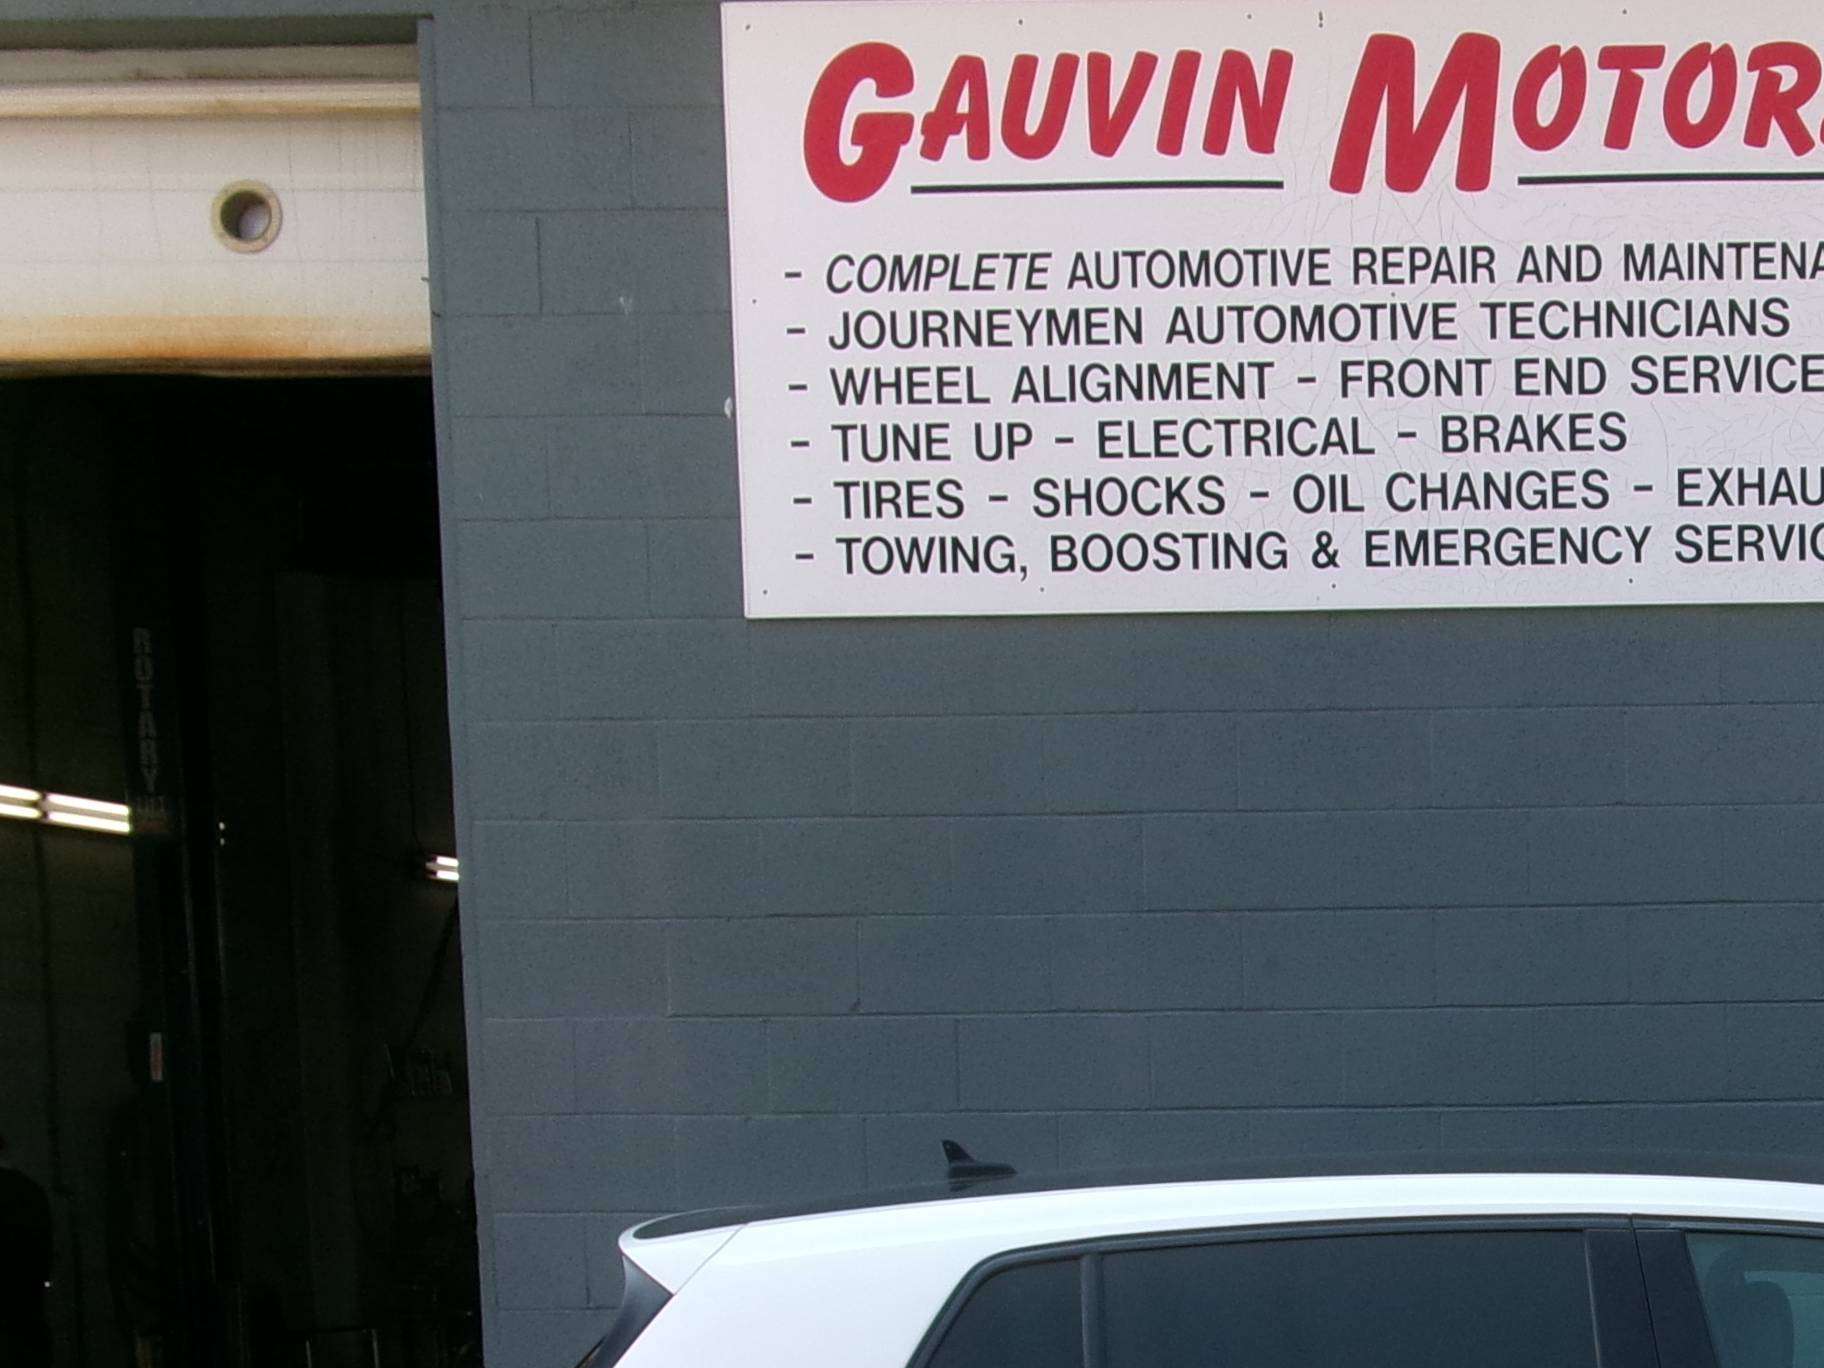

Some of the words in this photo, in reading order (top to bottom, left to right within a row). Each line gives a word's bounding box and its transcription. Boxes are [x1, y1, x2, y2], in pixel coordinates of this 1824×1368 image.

[803, 41, 1296, 204] GAUVIN
[826, 252, 1053, 294] COMPLETE
[1067, 248, 1332, 290] AUTOMOTIVE
[1353, 245, 1496, 285] REPAIR
[1516, 244, 1602, 284] AND
[828, 307, 1143, 350] JOURNEYMEN
[1165, 302, 1458, 345] AUTOMOTIVE
[1479, 297, 1790, 341] TECHNICIANS
[829, 366, 991, 406] WHEEL
[1011, 361, 1275, 404] ALIGNMENT
[1340, 358, 1492, 399] FRONT
[1514, 357, 1607, 397] END
[831, 422, 951, 463] TUNE
[974, 422, 1033, 462] UP
[1098, 416, 1376, 459] ELECTRICAL
[1441, 411, 1627, 454] BRAKES
[833, 478, 965, 520] TIRES
[1033, 474, 1226, 519] SHOCKS
[1293, 473, 1365, 514] OIL
[1385, 468, 1610, 513] CHANGES
[835, 534, 1028, 582] TOWING,
[1050, 530, 1288, 573] BOOSTING
[1311, 530, 1340, 570] &
[1365, 525, 1652, 568] EMERGENCY
[132, 626, 161, 794] ROTARY
